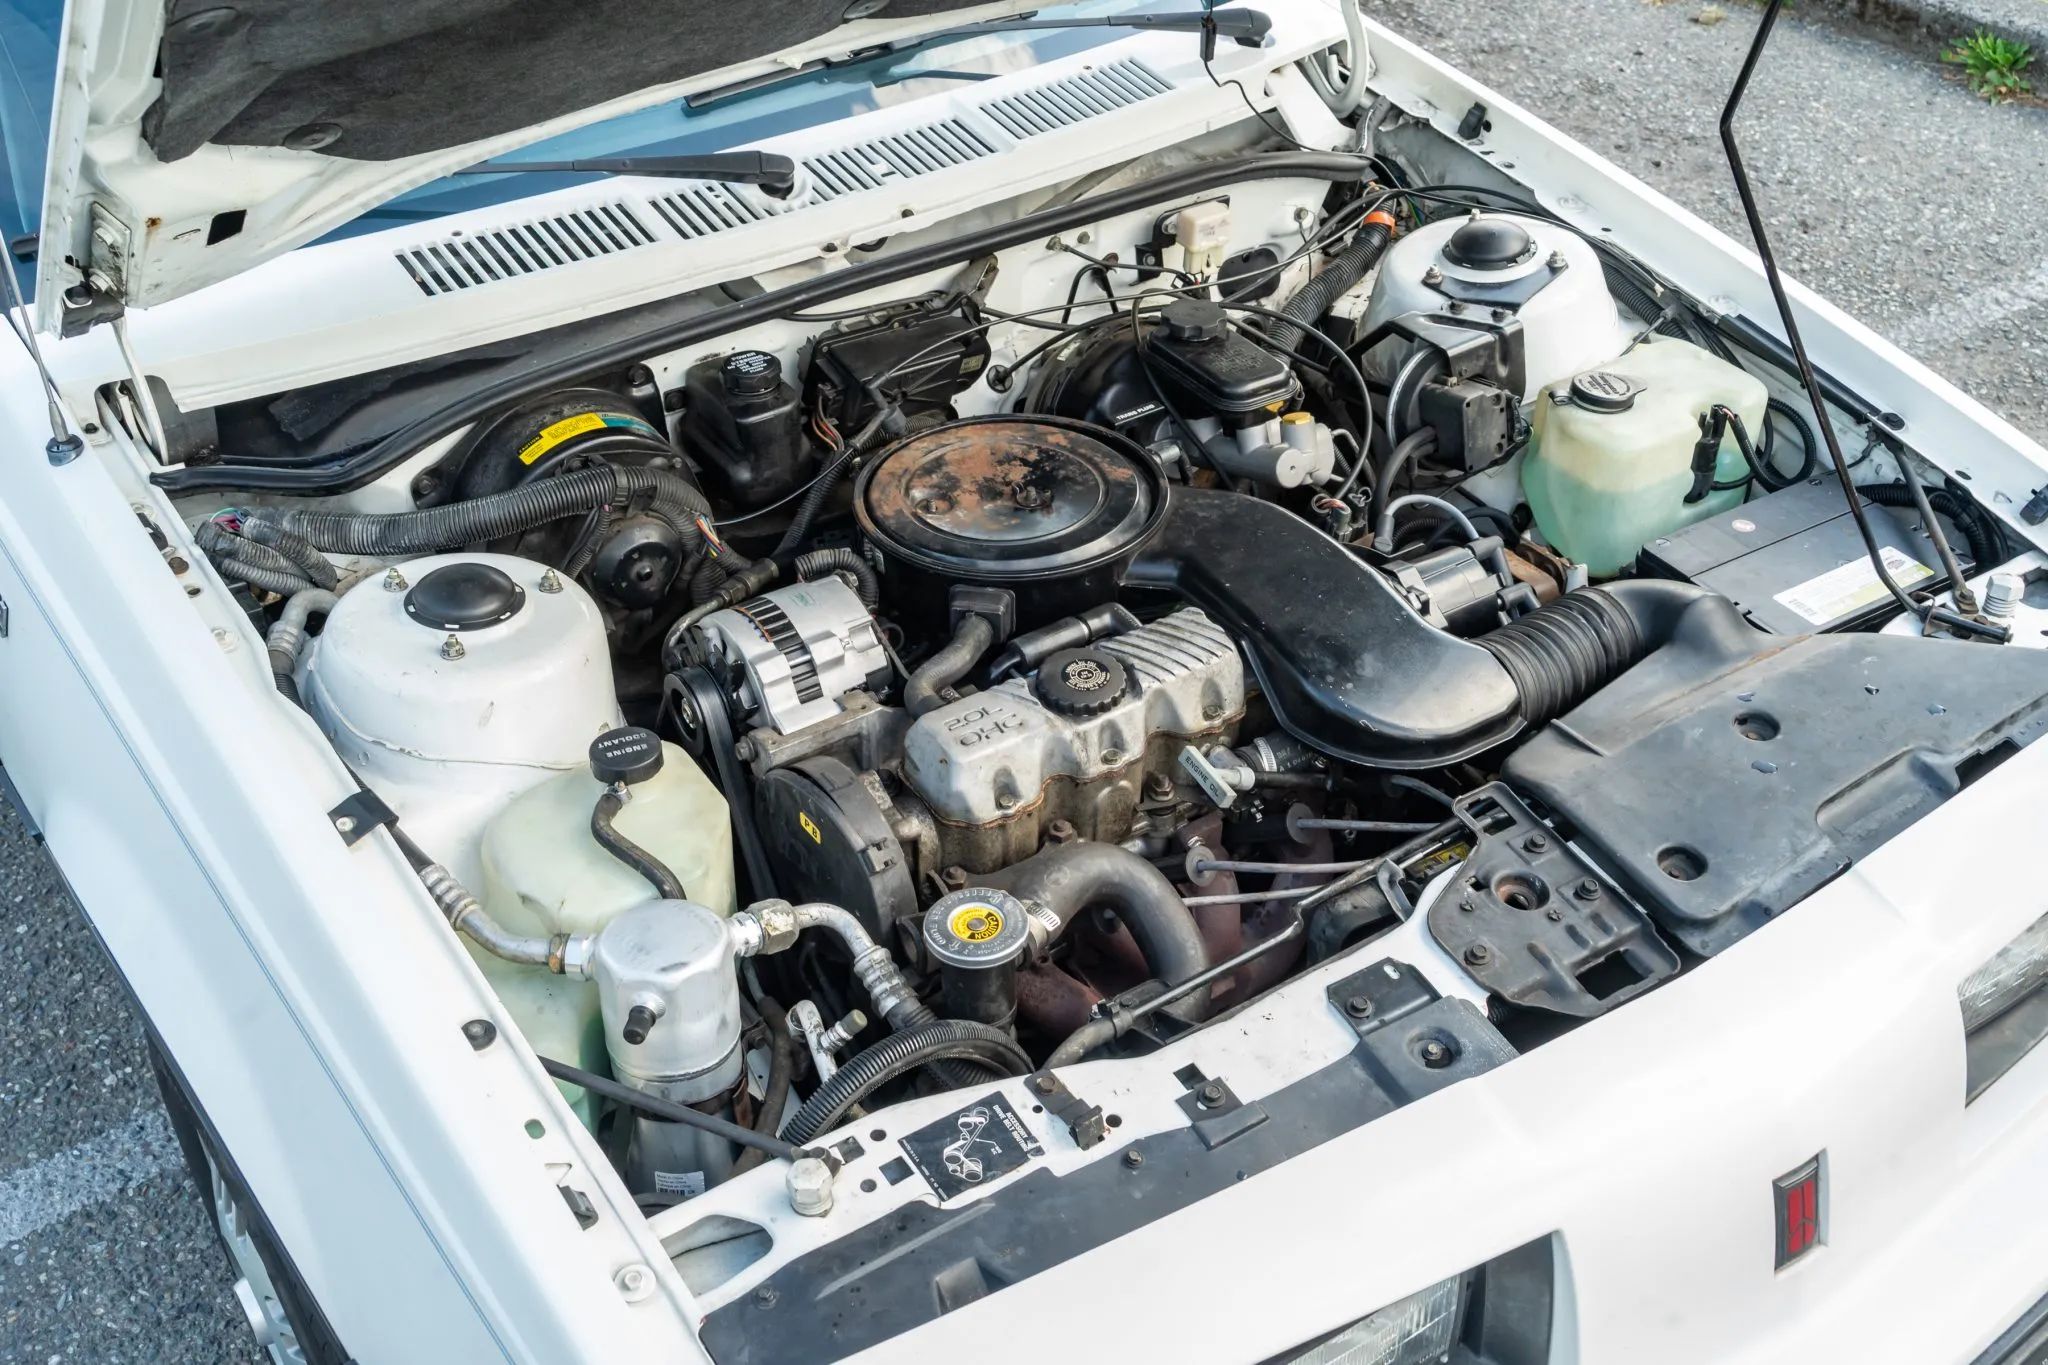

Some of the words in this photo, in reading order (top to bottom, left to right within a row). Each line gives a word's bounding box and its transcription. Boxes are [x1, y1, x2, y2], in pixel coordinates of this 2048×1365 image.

[731, 352, 756, 361] POWER
[731, 354, 764, 365] STEERING
[1116, 410, 1138, 420] TRANS
[1137, 404, 1155, 413] FLUID
[944, 706, 1003, 732] 2.0L
[960, 712, 1024, 747] OHC
[597, 732, 647, 749] COOLANT
[606, 743, 648, 758] ENGINE
[1185, 755, 1209, 783] ENGINE
[1209, 783, 1220, 797] OIL
[974, 915, 1000, 940] CAUTION
[992, 1104, 1006, 1120] DRIVE
[1003, 1118, 1015, 1131] BELT
[1011, 1130, 1028, 1152] ROUTING
[1005, 1111, 1028, 1138] ACCESSORY
